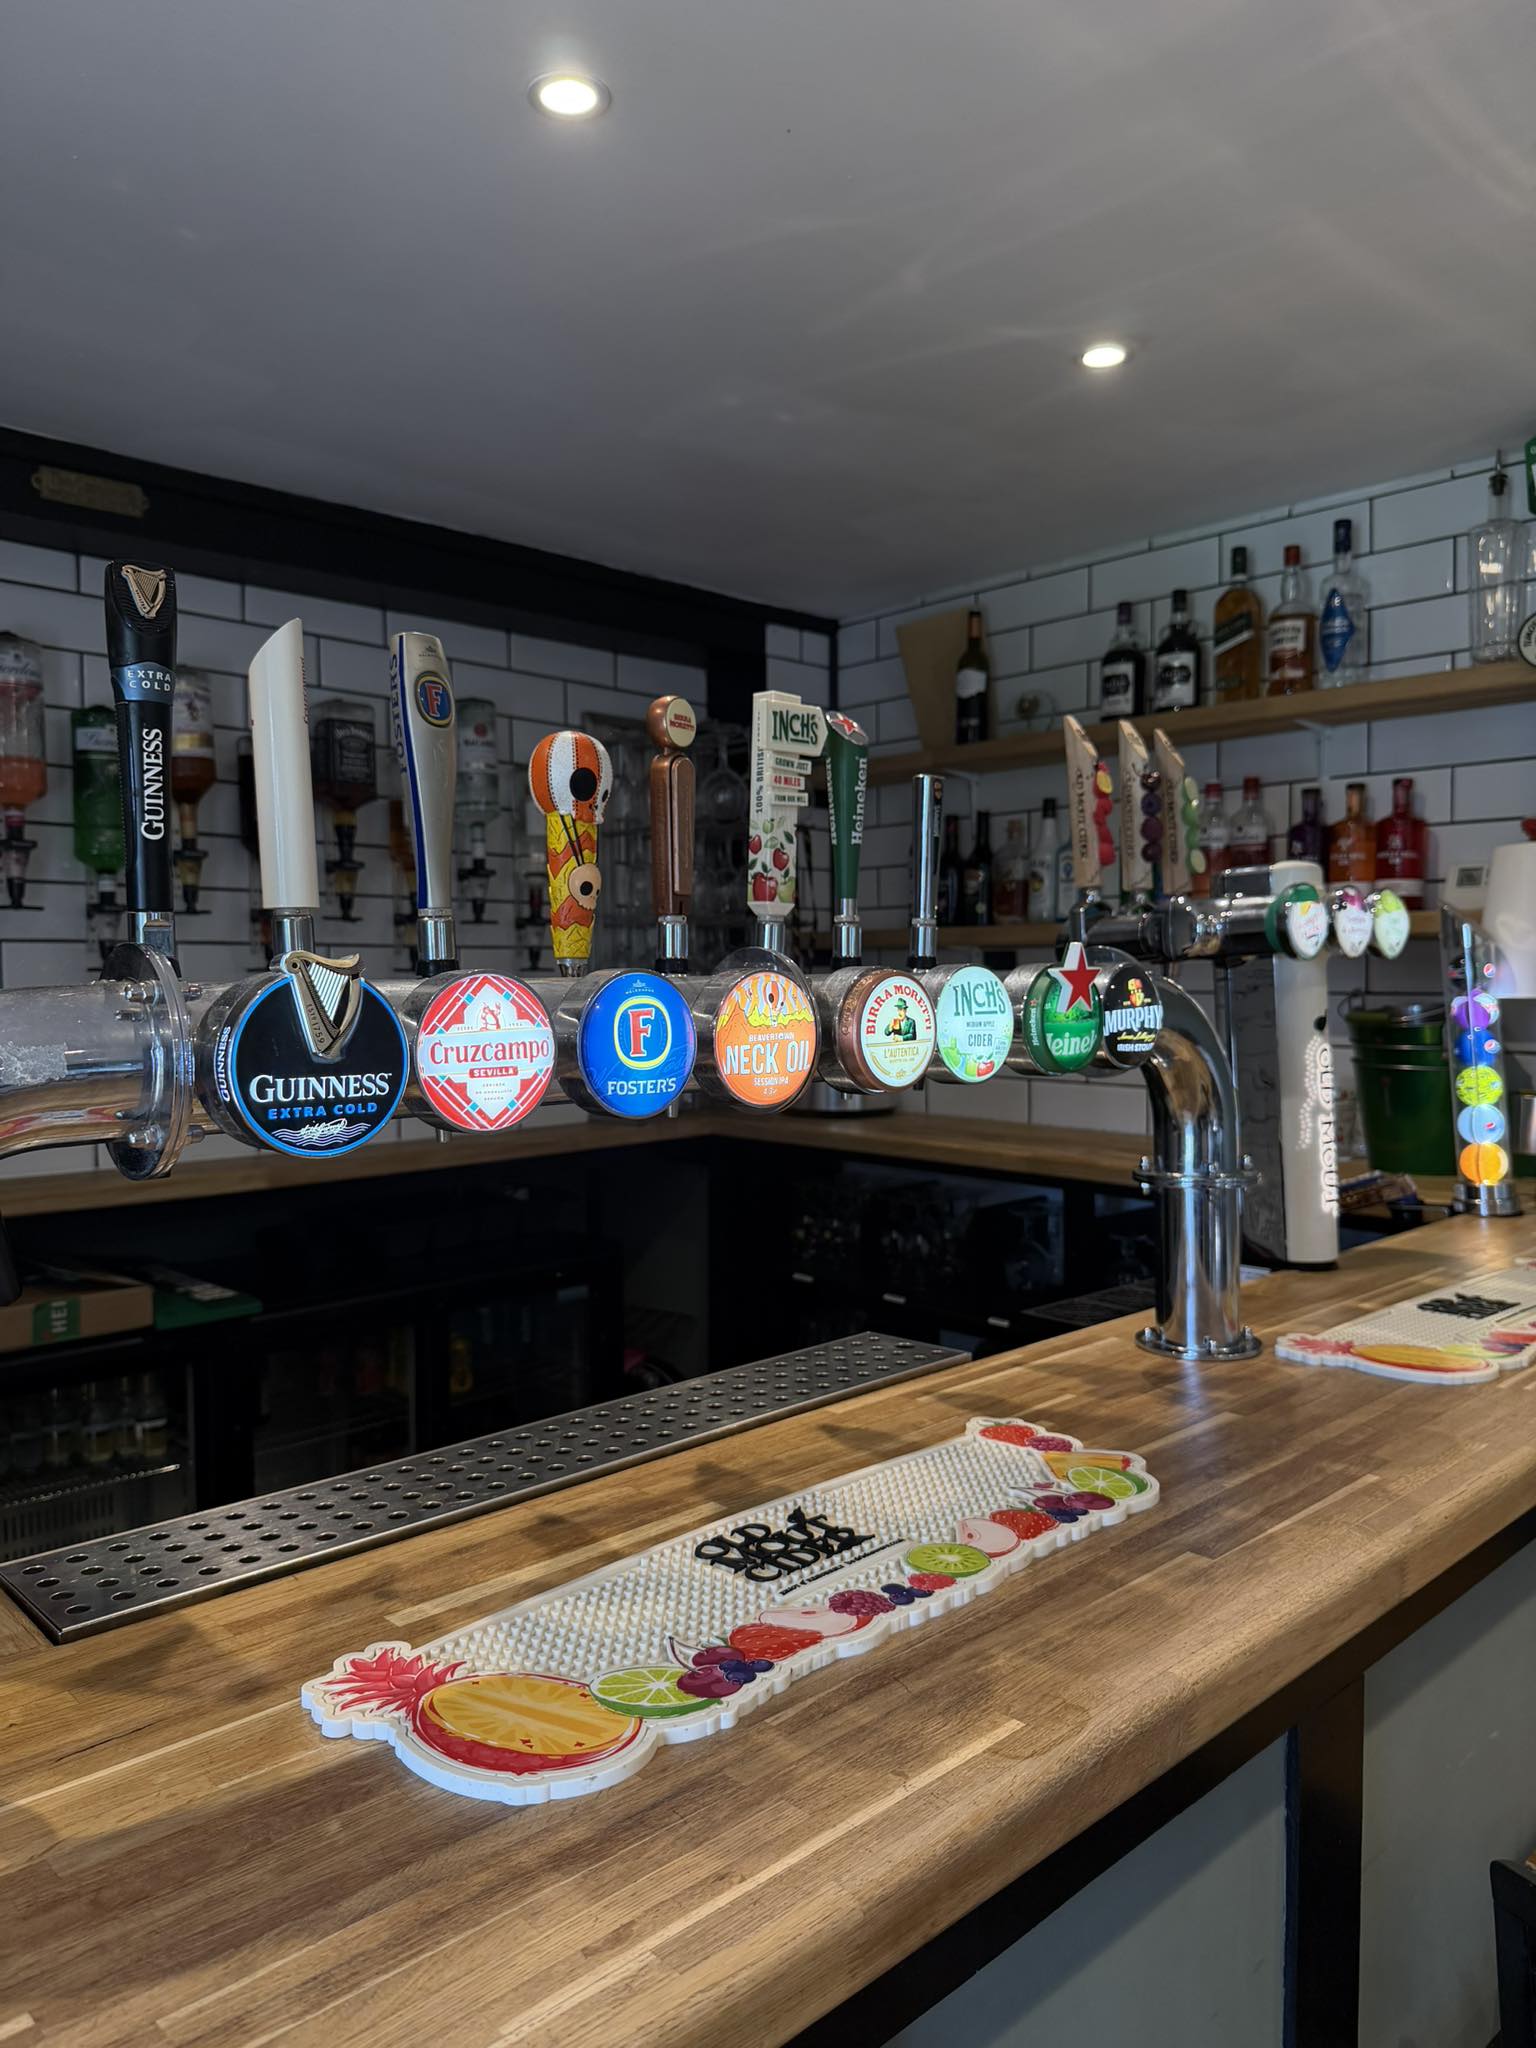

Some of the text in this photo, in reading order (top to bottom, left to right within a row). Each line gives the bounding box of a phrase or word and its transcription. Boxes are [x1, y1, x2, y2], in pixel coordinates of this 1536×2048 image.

[127, 669, 171, 681] EXTRA
[129, 680, 171, 692] COLD
[425, 682, 443, 718] F
[772, 709, 819, 743] INCH'S
[141, 728, 165, 841] GUINNESS
[773, 775, 801, 788] 40 MILES
[756, 785, 765, 814] 100%
[852, 757, 868, 845] Heineken
[866, 989, 893, 1035] BIRRA
[893, 985, 932, 1030] MORETTI
[953, 981, 1006, 1016] INCH'S
[628, 1008, 655, 1057] F
[750, 1032, 795, 1043] BEAVERTOWN
[968, 1034, 993, 1047] CIDER
[216, 1025, 231, 1102] GUINNESS
[430, 1039, 550, 1065] Cruzcampo
[724, 1043, 779, 1075] NECK
[786, 1039, 810, 1073] OIL
[473, 1067, 513, 1077] SEVILLA
[607, 1078, 677, 1095] FOSTER'S
[250, 1073, 390, 1103] GUINNESS
[267, 1102, 378, 1120] EXTRA COLD
